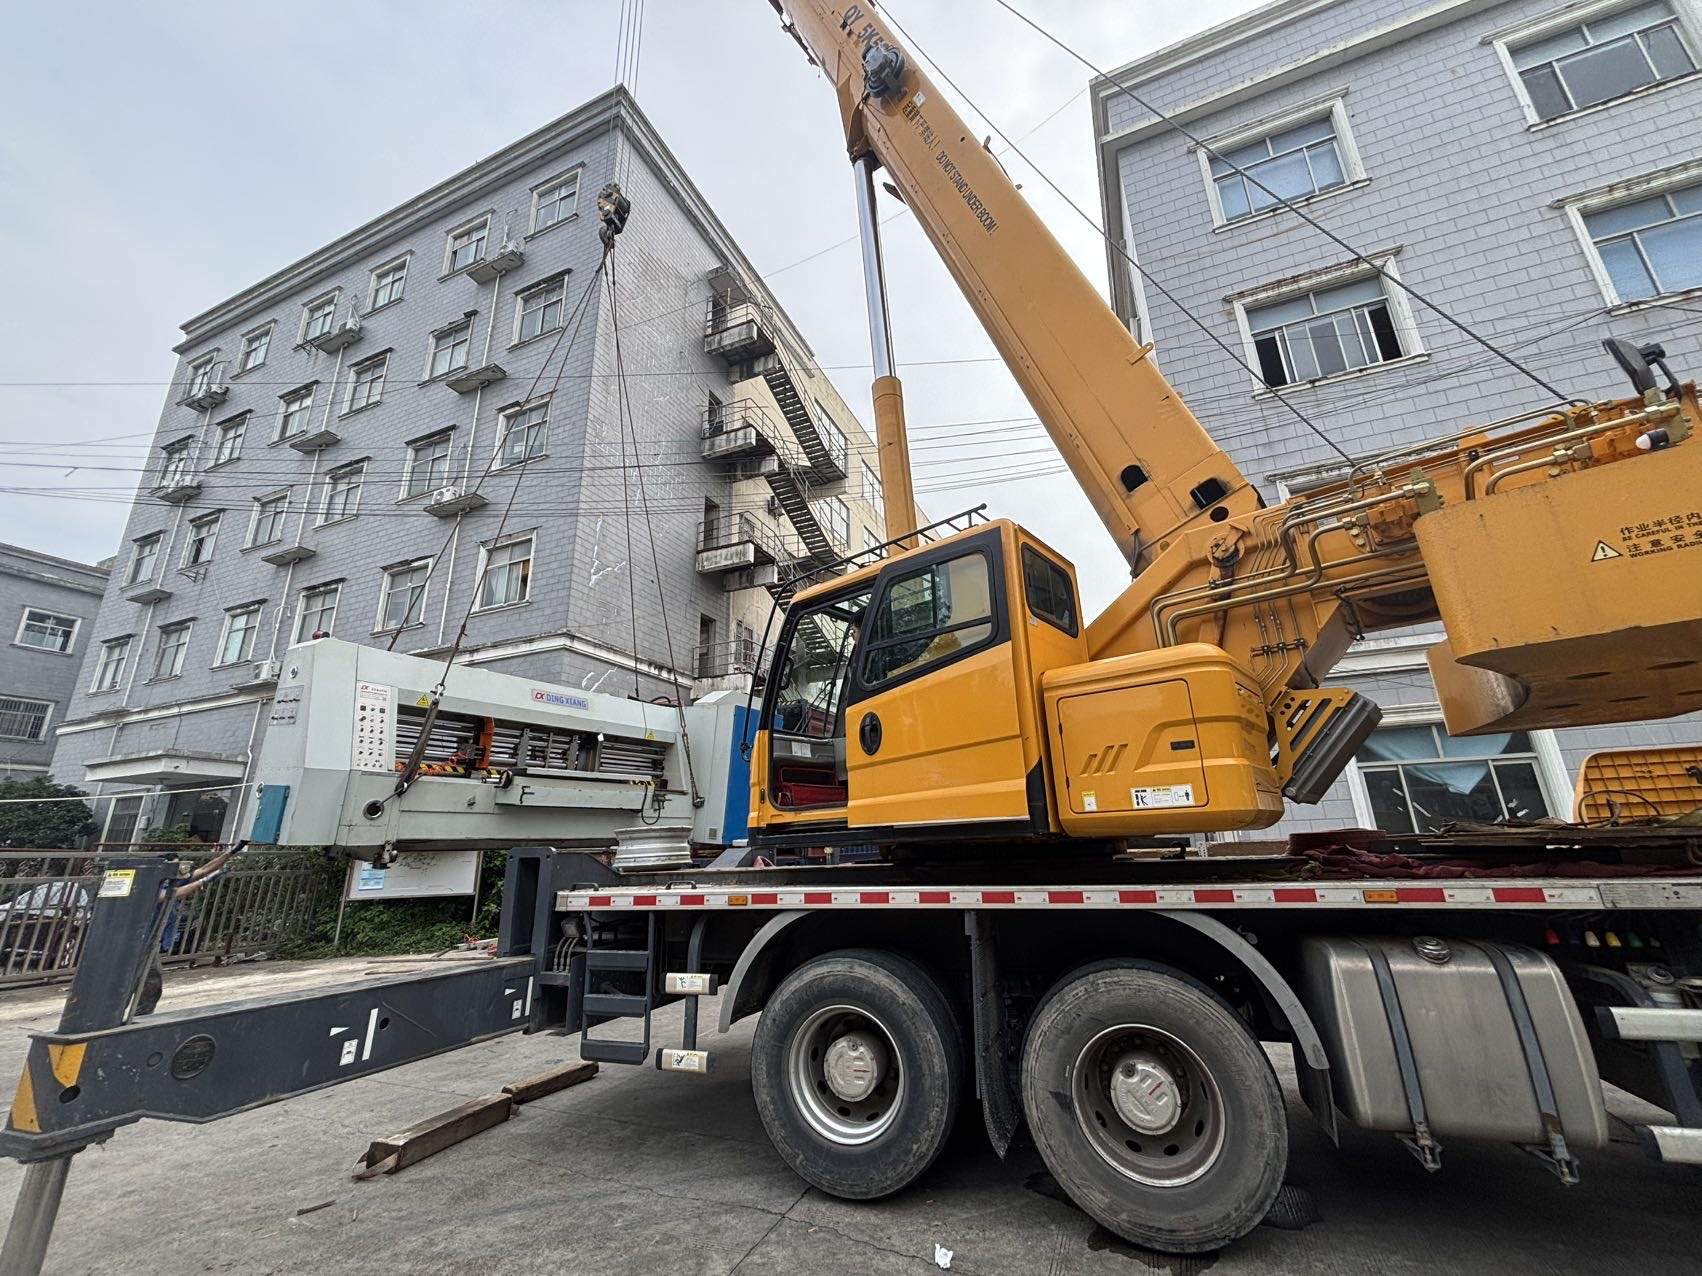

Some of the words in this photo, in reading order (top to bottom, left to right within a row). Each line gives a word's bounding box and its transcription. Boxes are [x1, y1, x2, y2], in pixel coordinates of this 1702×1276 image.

[949, 169, 968, 193] STAND
[962, 187, 983, 213] UNDER
[1620, 512, 1702, 536] 作业半径内
[1635, 527, 1672, 539] CAREFUL
[1629, 546, 1673, 558] WORKING
[546, 693, 564, 704] DING
[565, 698, 587, 708] XIANG
